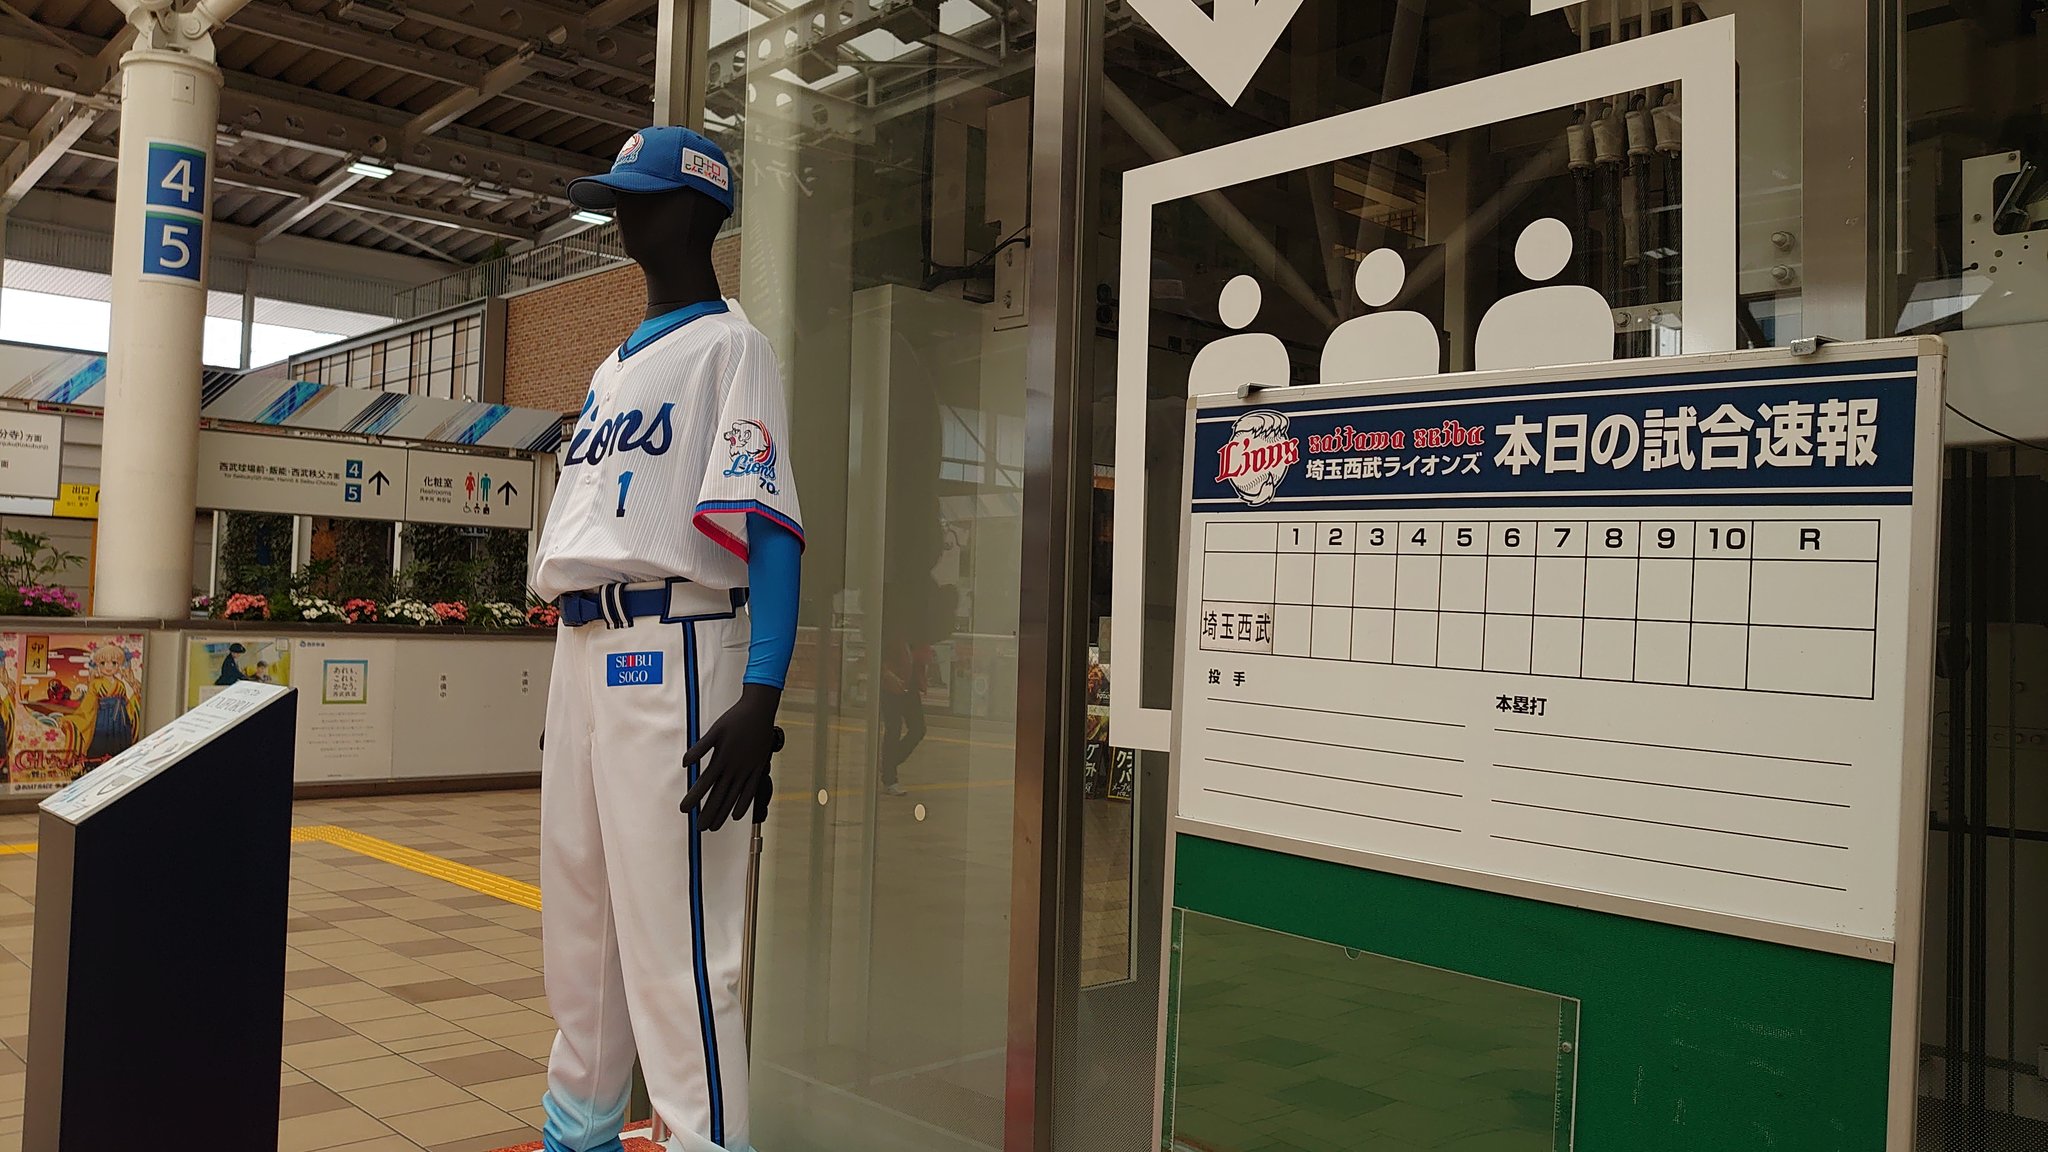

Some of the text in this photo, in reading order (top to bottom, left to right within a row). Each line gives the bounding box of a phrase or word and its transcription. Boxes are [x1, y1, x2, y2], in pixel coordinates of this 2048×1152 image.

[161, 159, 195, 203] 4
[159, 224, 190, 269] 5
[563, 389, 676, 467] Lions
[1308, 425, 1405, 454] saitama
[1493, 398, 1880, 476] 本日の試合速報
[348, 463, 360, 477] 4
[723, 454, 778, 480] Lions
[1215, 437, 1300, 483] Lions
[1305, 452, 1483, 481] 埼玉西武ライオンズ
[72, 485, 91, 495] 出口
[348, 486, 358, 501] 5
[424, 476, 453, 488] 化粧室
[615, 470, 634, 518] 1
[1292, 527, 1821, 551] 1 2 3 4 5 6 7 8 9 10 R
[1202, 610, 1272, 644] 埼玉西武
[615, 654, 652, 668] SEIBU
[618, 670, 649, 683] SOGO
[1495, 694, 1547, 716] 本塁打
